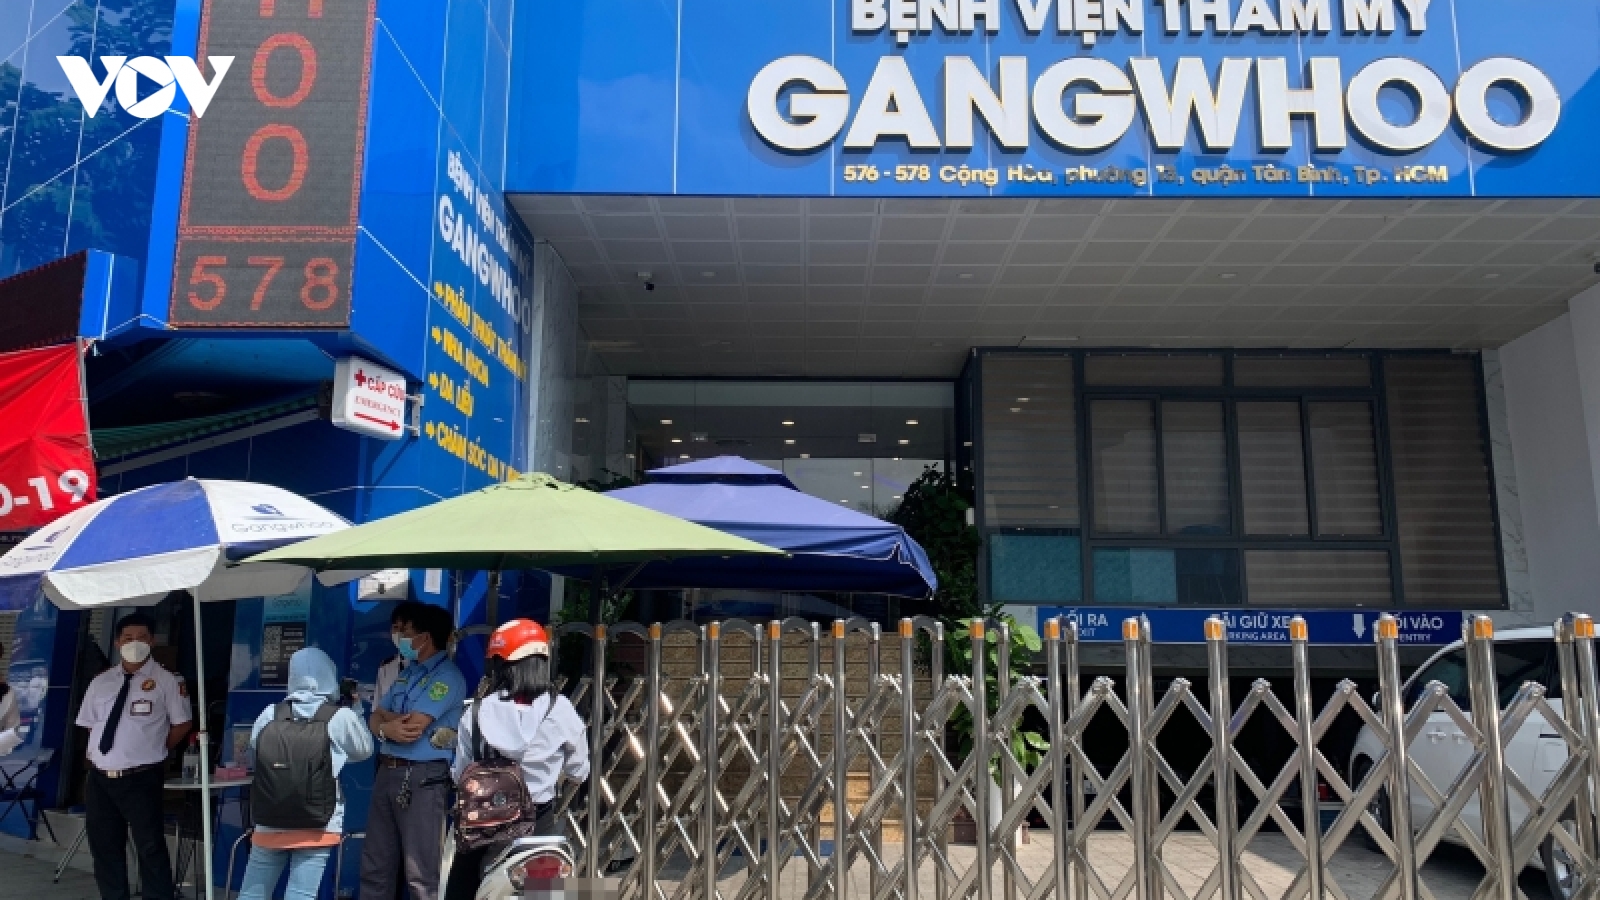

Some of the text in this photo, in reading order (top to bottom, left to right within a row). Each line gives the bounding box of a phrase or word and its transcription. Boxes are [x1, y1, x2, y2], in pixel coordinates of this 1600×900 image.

[241, 0, 323, 202] OO
[747, 55, 1561, 150] GANGWHOO
[844, 165, 879, 182] 576
[894, 165, 931, 182] 578
[940, 164, 999, 187] Cộng
[1192, 164, 1247, 187] quận
[1252, 164, 1291, 182] Tân
[1298, 163, 1348, 186] Bình,
[1354, 165, 1388, 184] Tp.
[1395, 165, 1448, 182] HCM
[187, 255, 339, 311] 578
[439, 194, 531, 334] GANGWHOO
[439, 372, 454, 404] DA
[1088, 613, 1108, 626] RA
[1410, 614, 1444, 630] VÀO
